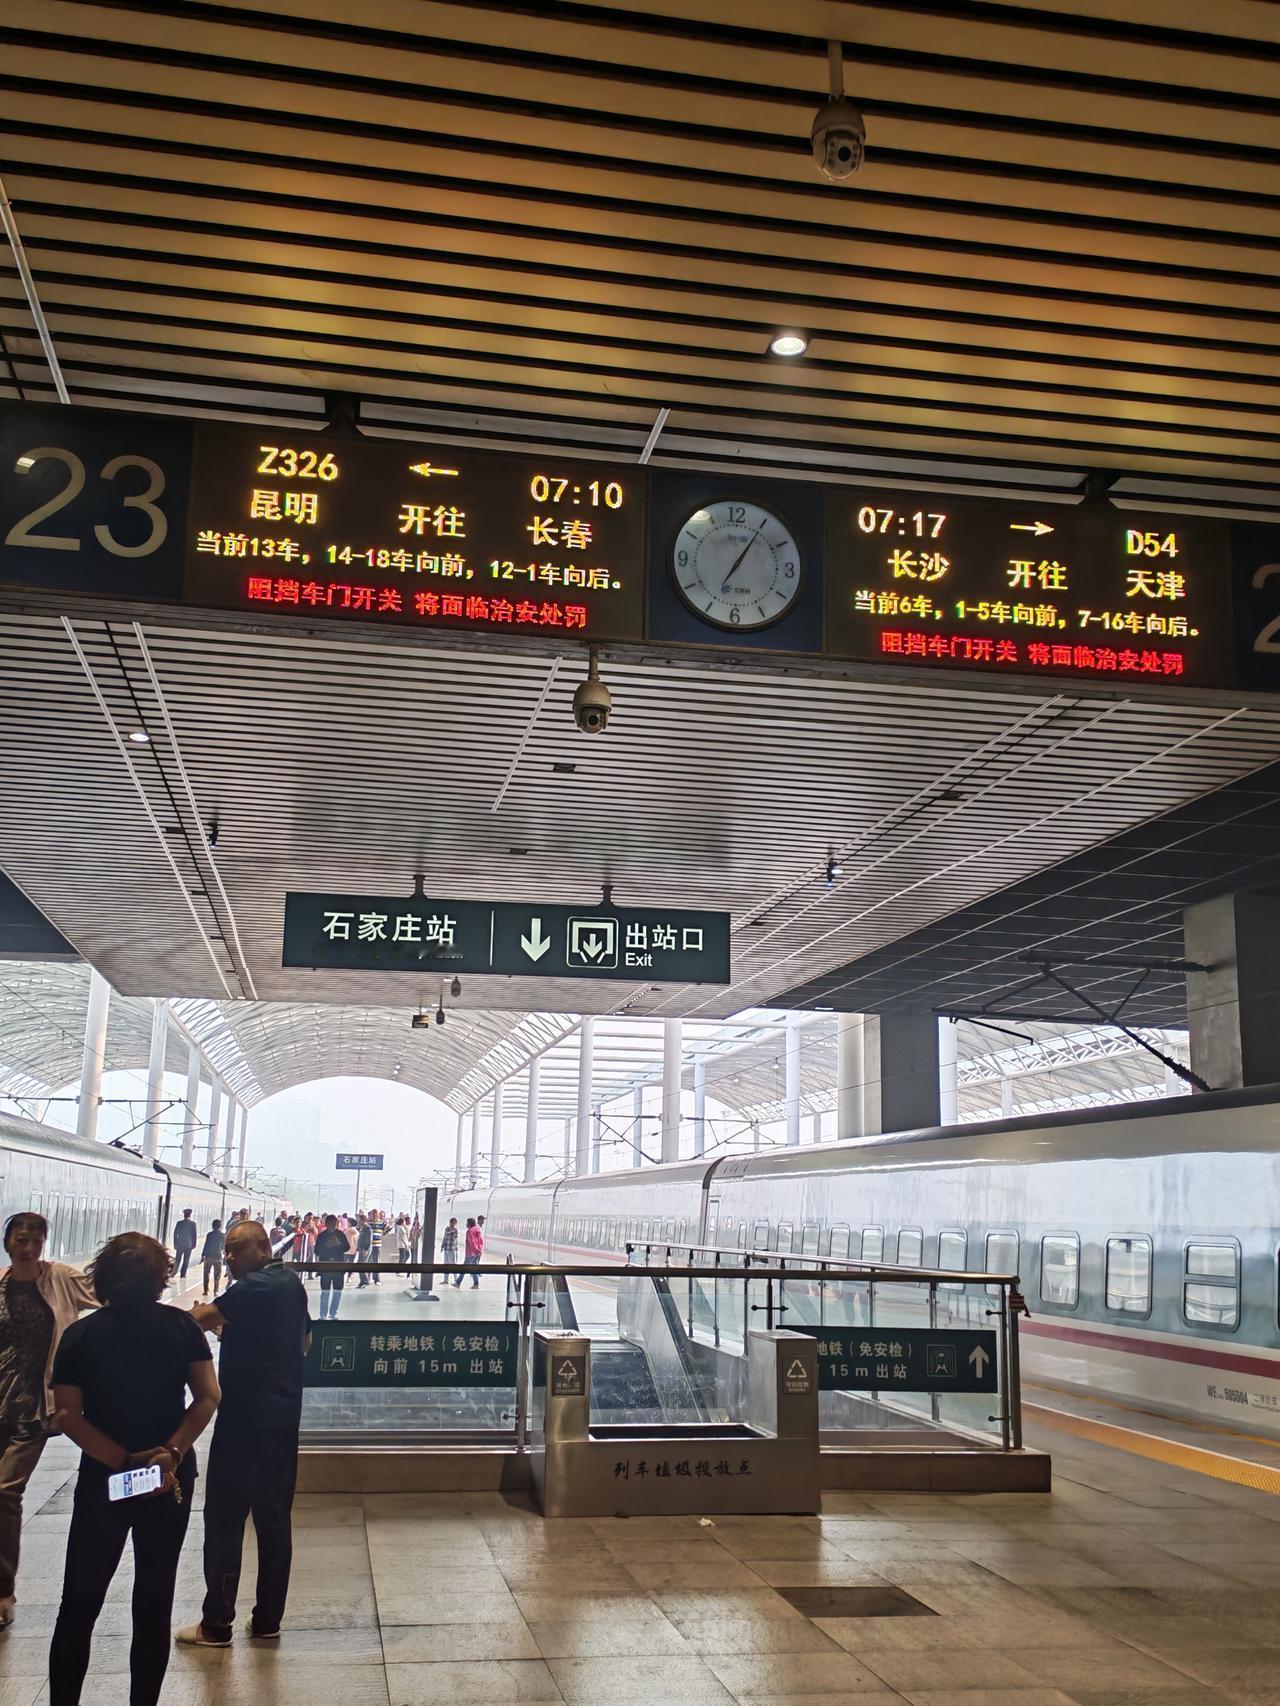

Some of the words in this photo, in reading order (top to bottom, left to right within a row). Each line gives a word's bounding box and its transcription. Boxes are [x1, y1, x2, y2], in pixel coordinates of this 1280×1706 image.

[257, 446, 339, 481] Z326
[4, 446, 169, 558] 23
[250, 489, 319, 524] 昆明
[530, 474, 624, 509] 07:10
[398, 504, 467, 538] 开往
[727, 506, 746, 524] 12
[858, 506, 947, 538] 07:17
[526, 516, 594, 550] 长春
[1126, 529, 1179, 557] D54
[678, 550, 689, 567] 9
[784, 562, 795, 579] 3
[887, 549, 951, 582] 长沙
[1006, 559, 1069, 590] 开往
[1125, 569, 1186, 601] 天津
[248, 577, 402, 612] 阻挡车门开关
[414, 592, 588, 629] 将面临治安处罚
[729, 607, 741, 624] 6
[881, 632, 1018, 663] 阻挡车门开关
[1027, 642, 1184, 675] 将面临治安处罚
[322, 911, 457, 945] 石家庄站
[625, 923, 704, 951] 出站口
[625, 953, 653, 967] Exit
[614, 1458, 752, 1480] 列车垃圾投放点
